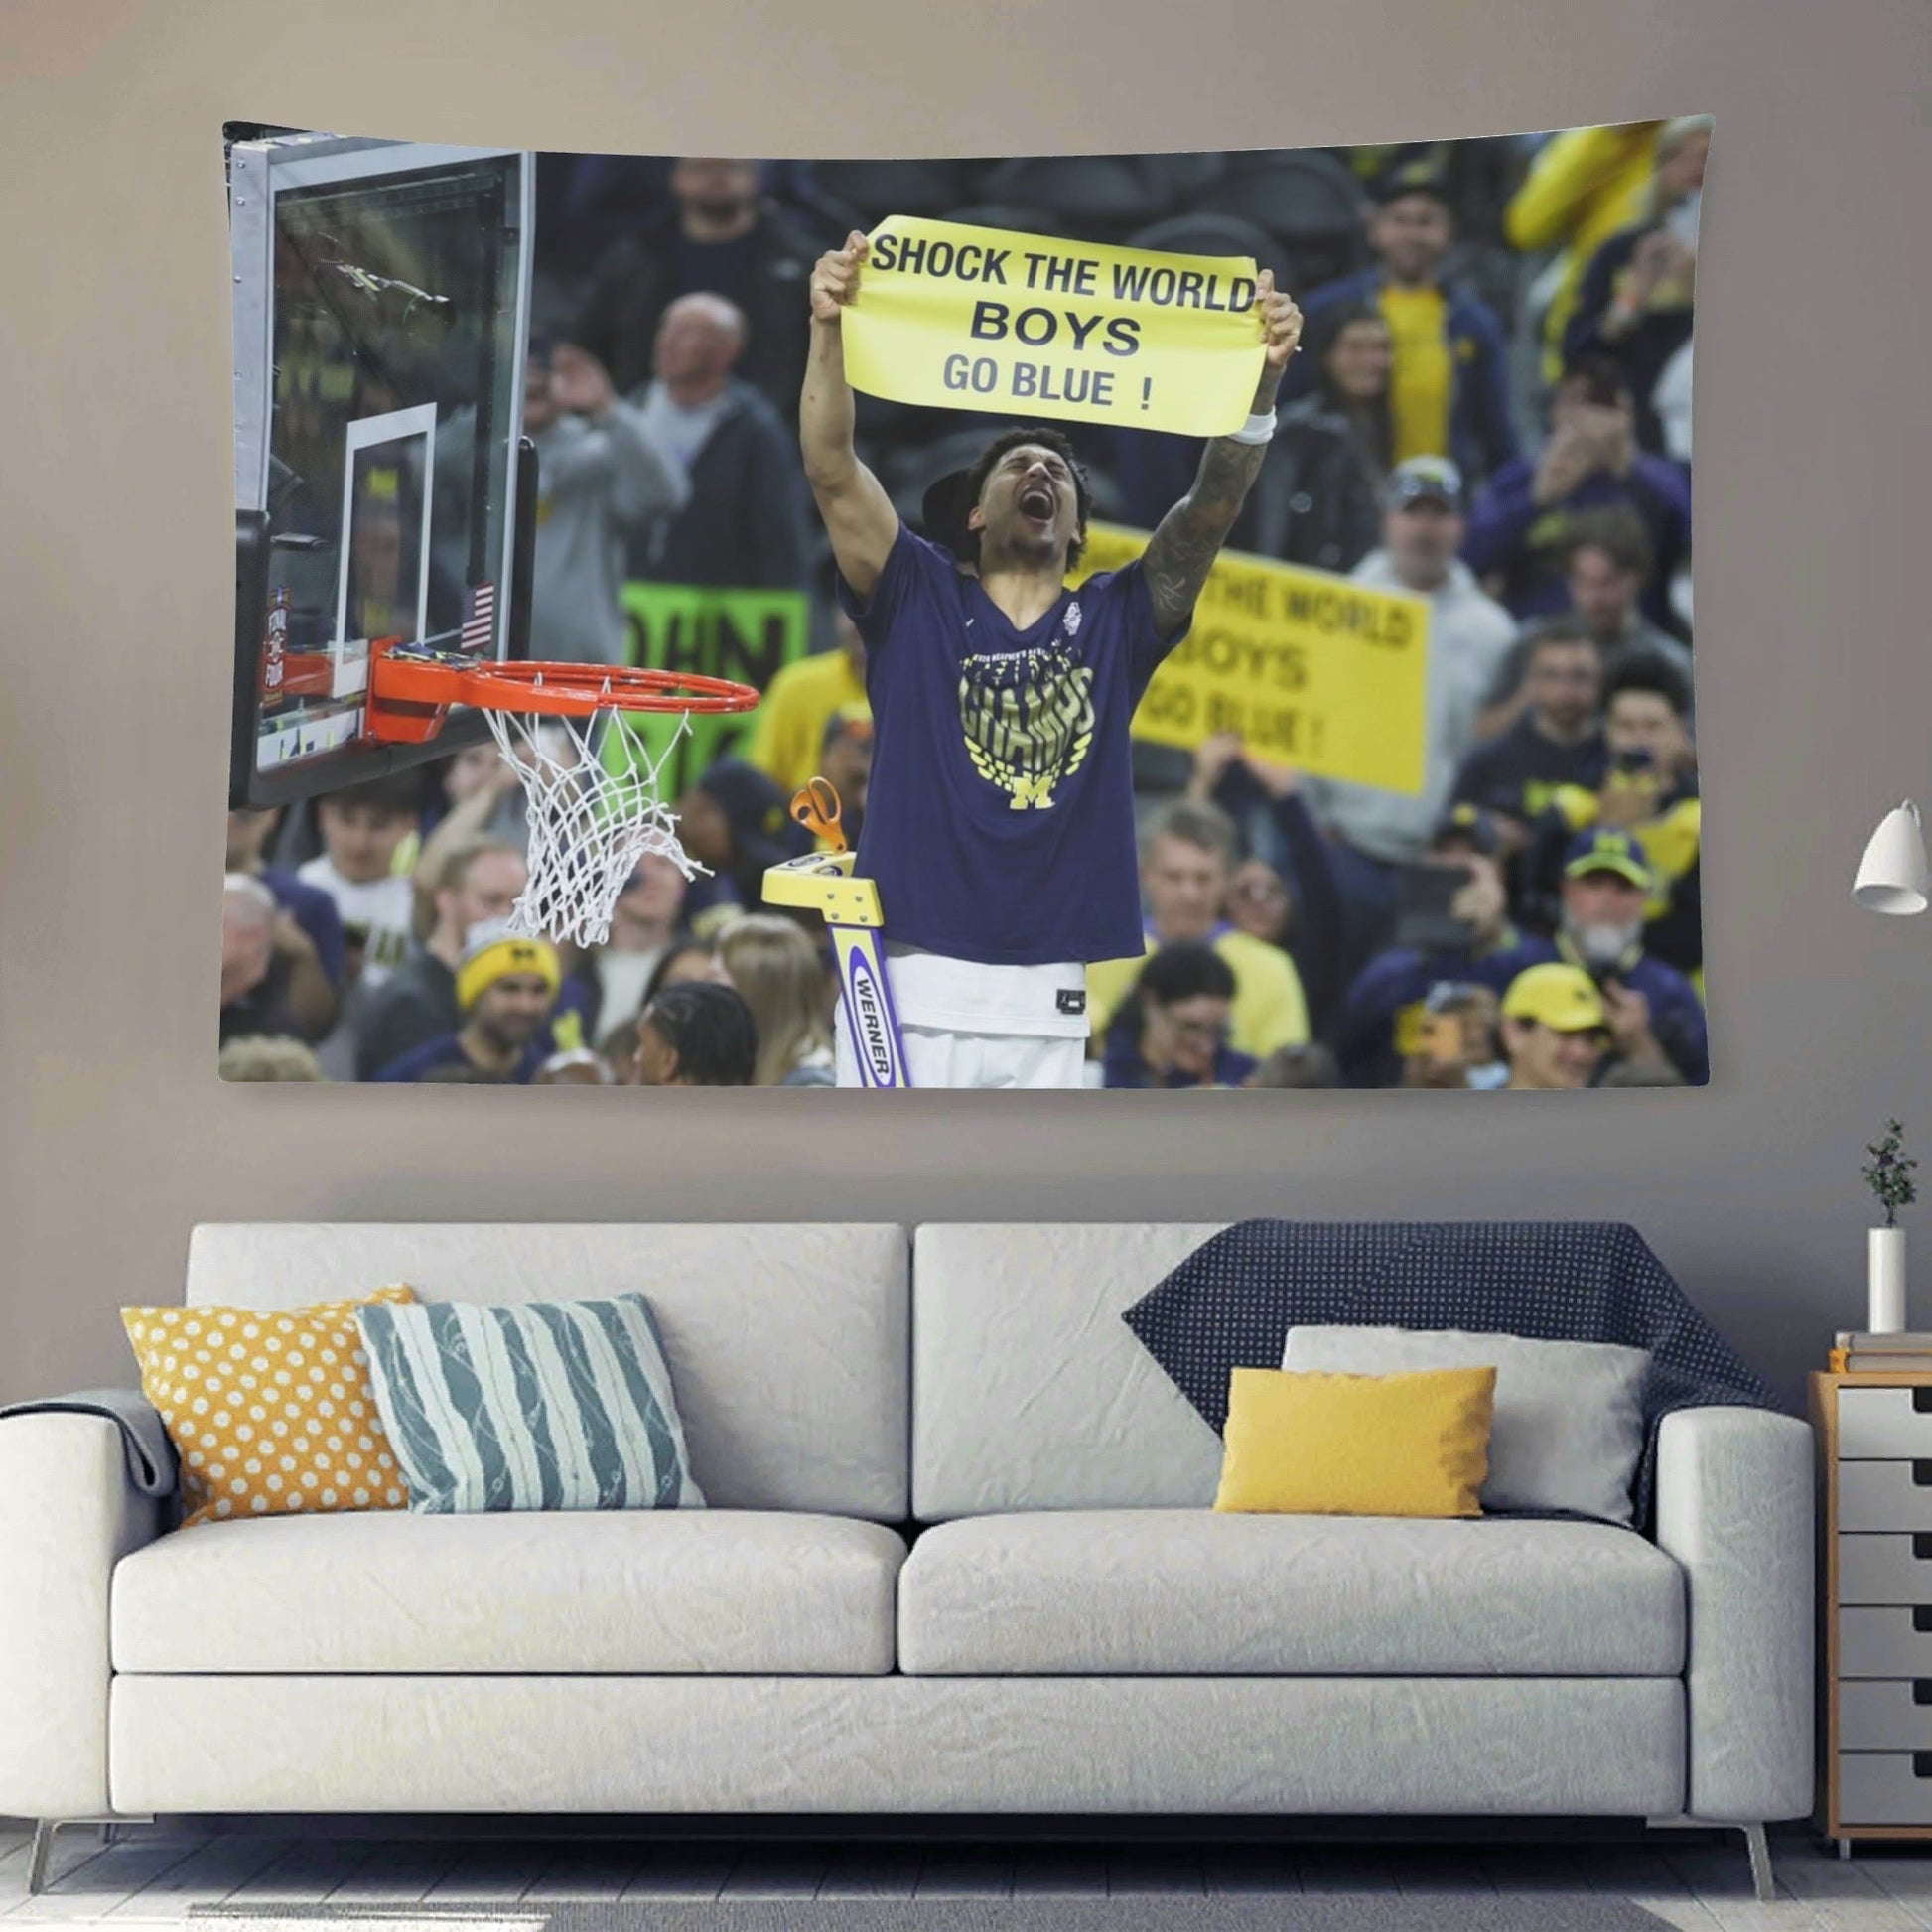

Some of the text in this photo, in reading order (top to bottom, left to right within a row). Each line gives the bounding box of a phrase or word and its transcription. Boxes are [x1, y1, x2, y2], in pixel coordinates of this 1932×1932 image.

[872, 234, 1257, 314] SHOCK THE WORLD
[970, 301, 1141, 357] BOYS
[943, 354, 1152, 410] GO BLUE !
[1285, 587, 1413, 649] WORLD
[1010, 777, 1055, 809] M
[858, 978, 889, 1075] WERNER
